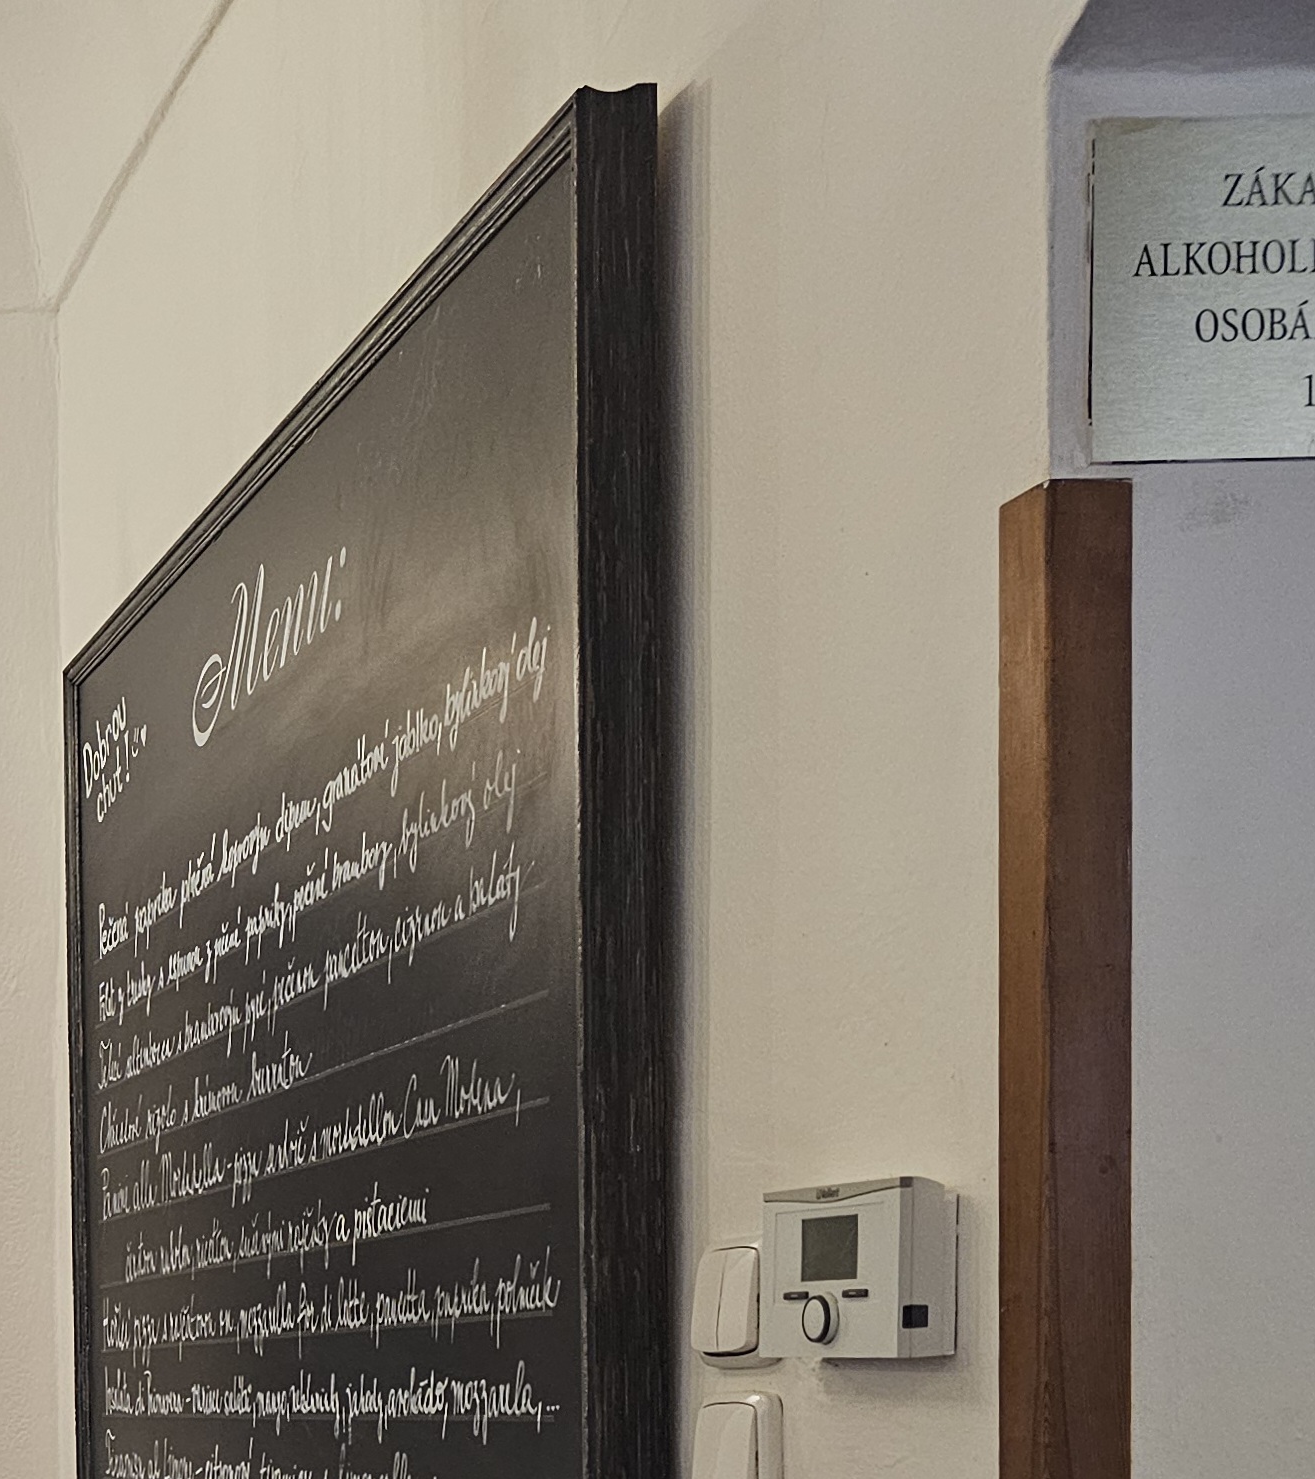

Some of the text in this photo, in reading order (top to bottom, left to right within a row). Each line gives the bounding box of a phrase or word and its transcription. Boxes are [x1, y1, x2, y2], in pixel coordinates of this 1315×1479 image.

[1195, 300, 1315, 343] OSOBÁ
[192, 547, 347, 747] Menu:
[515, 617, 551, 701] olej
[83, 697, 126, 799] Dobrou
[483, 749, 521, 833] olej
